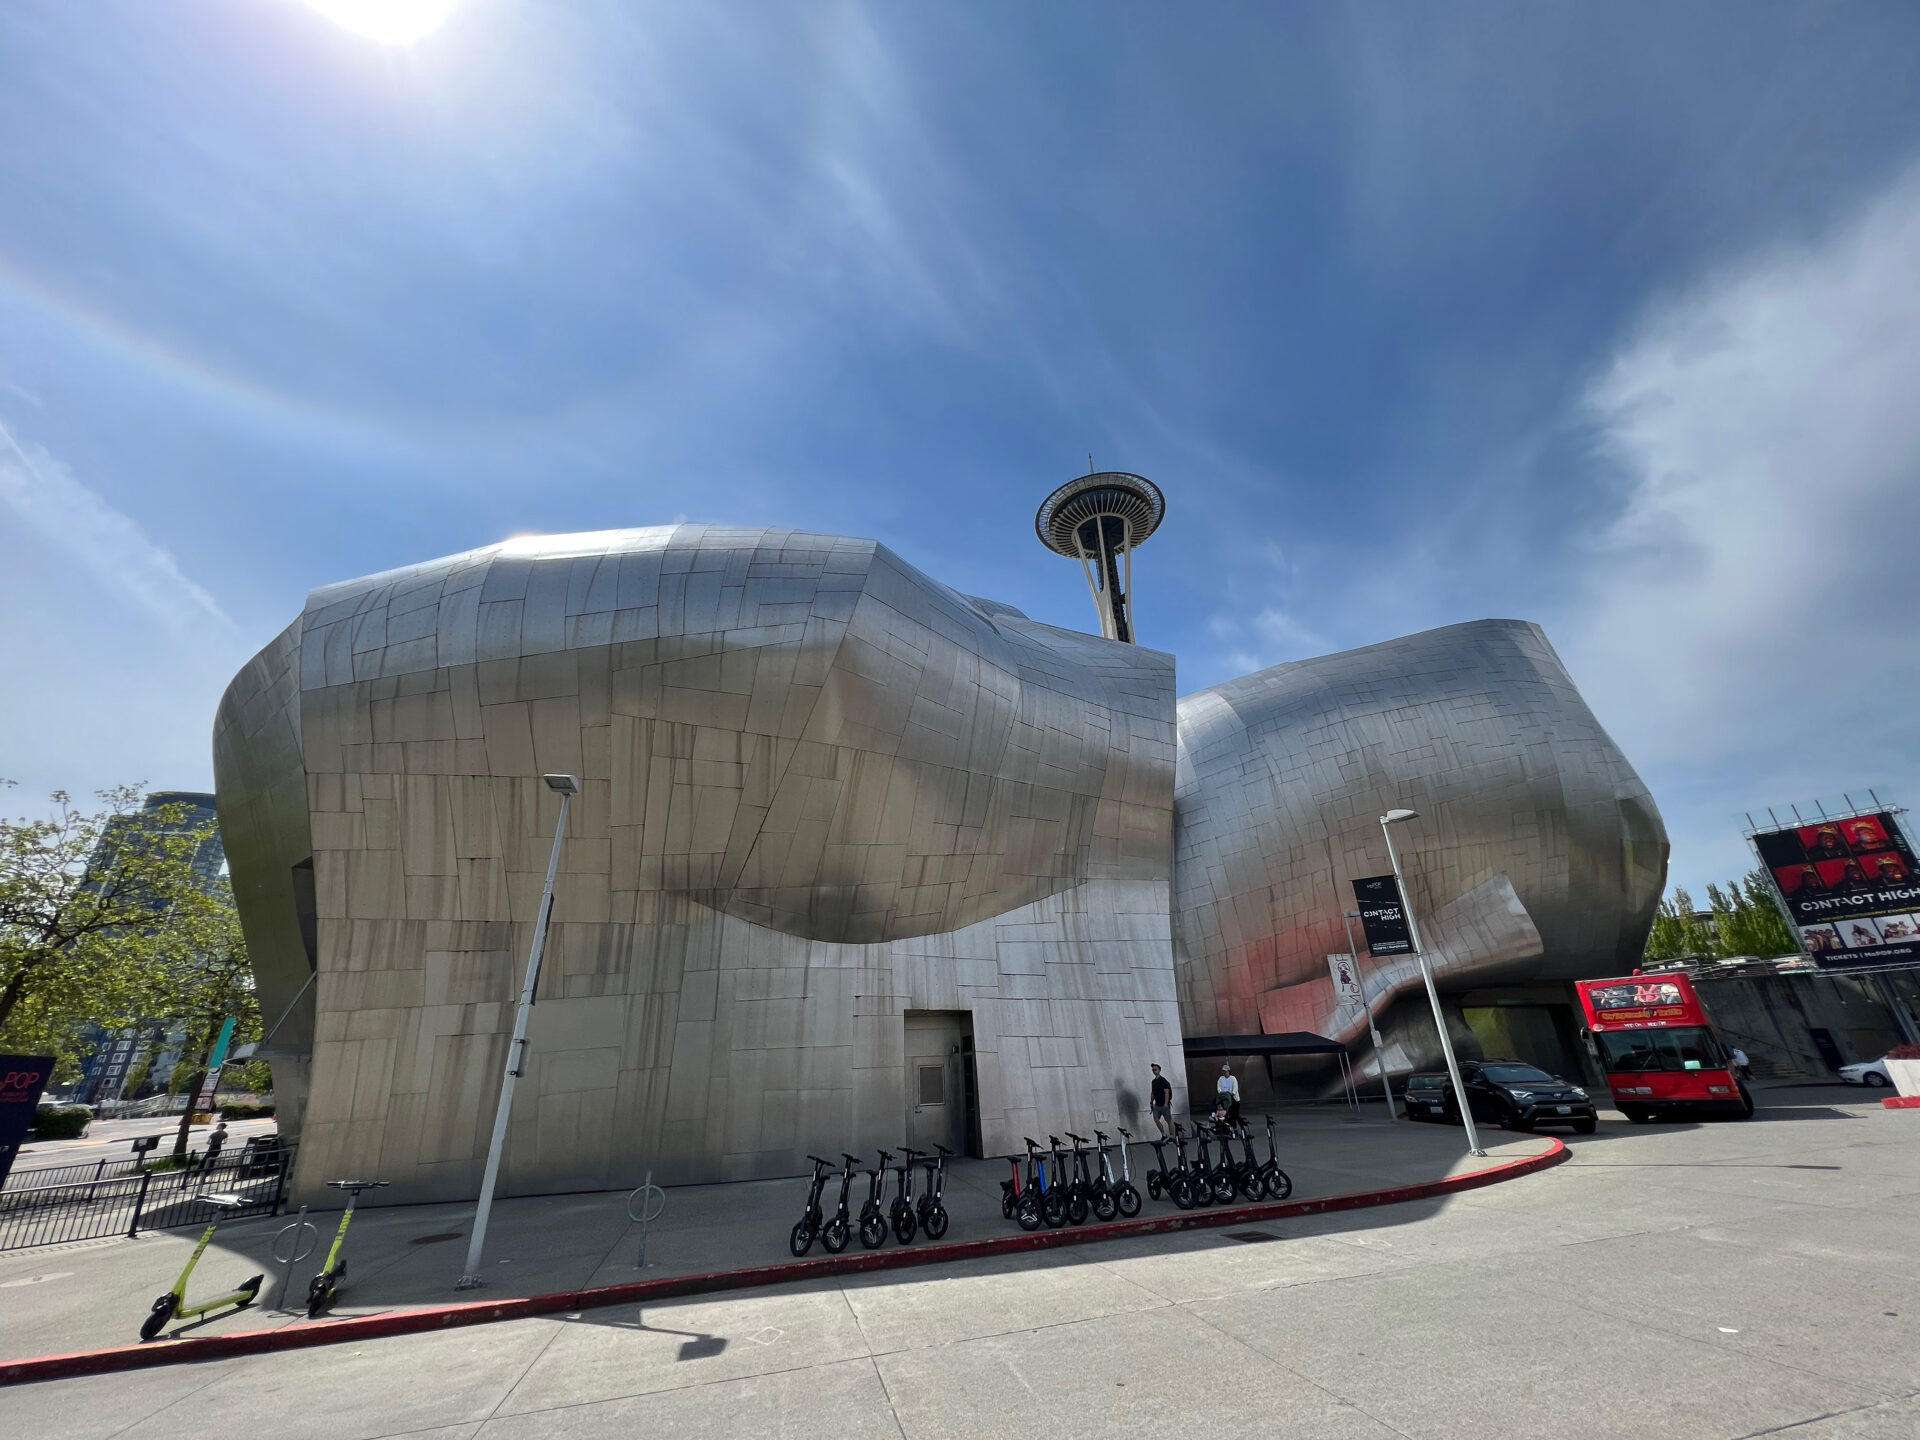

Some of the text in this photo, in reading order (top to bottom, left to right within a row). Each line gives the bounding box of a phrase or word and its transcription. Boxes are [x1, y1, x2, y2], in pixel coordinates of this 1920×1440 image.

[1801, 887, 1920, 911] CONTACT HIGH
[1363, 908, 1399, 917] CONTACT
[1825, 953, 1858, 961] TICKETS
